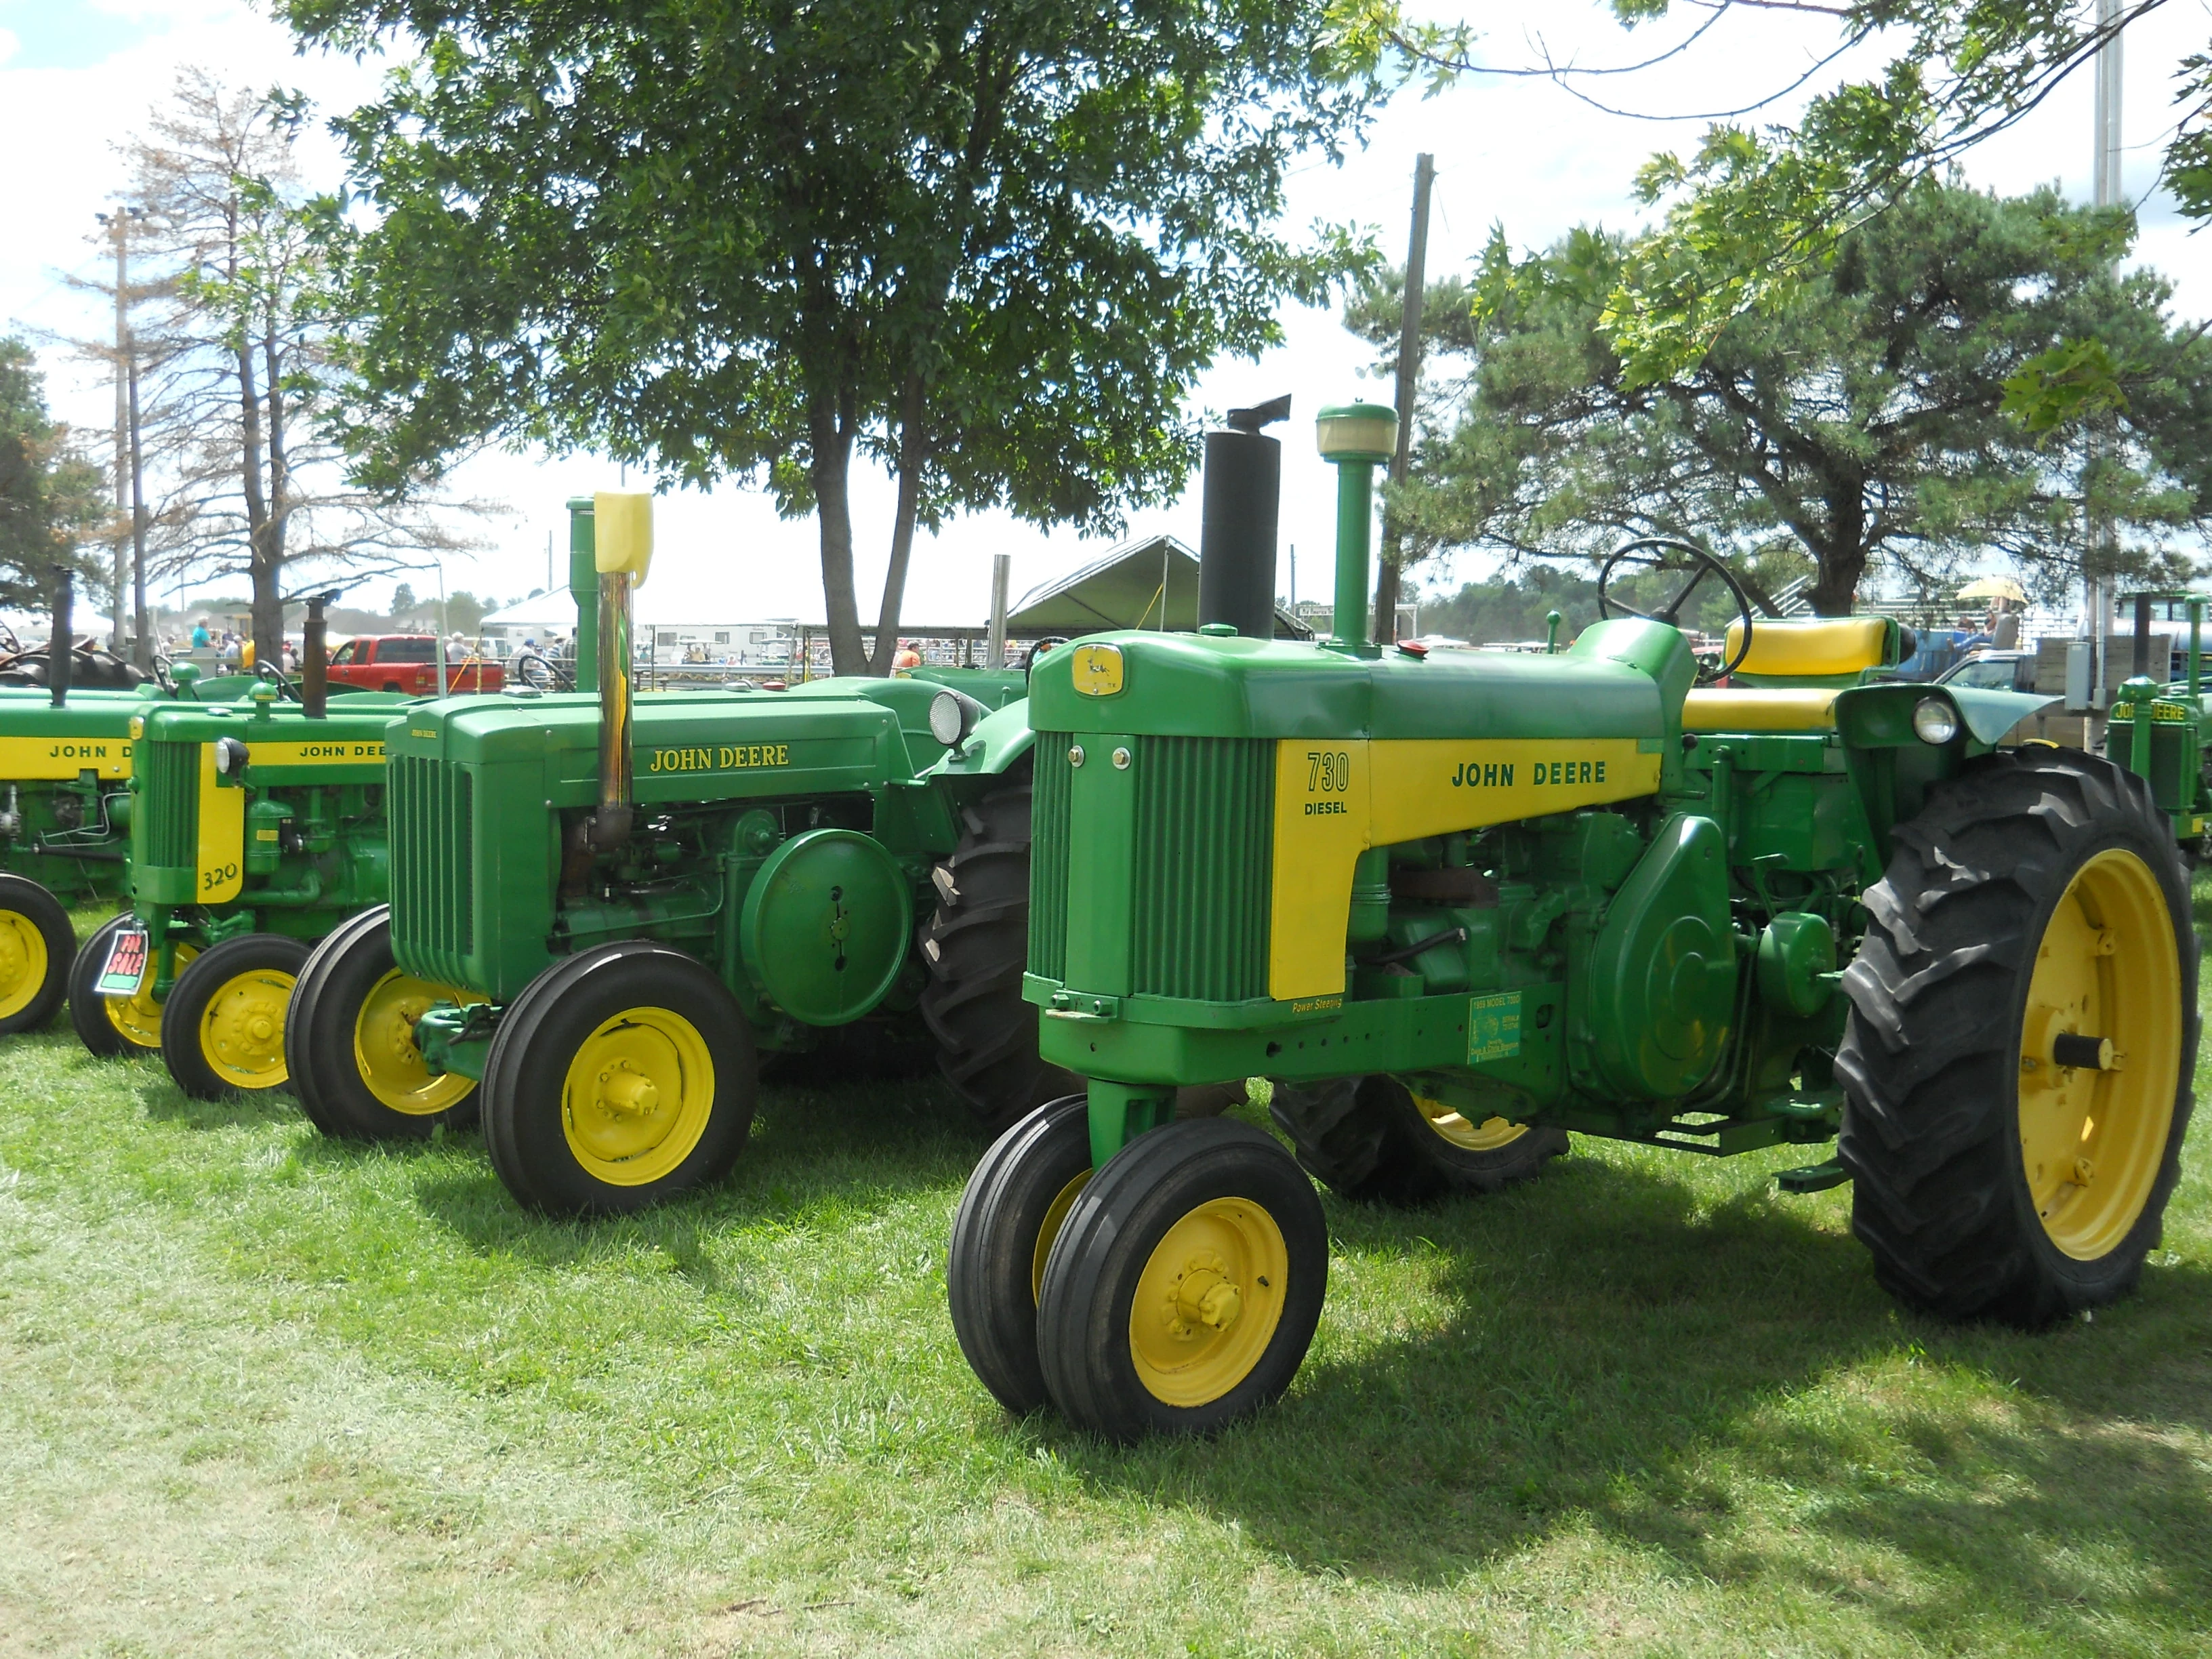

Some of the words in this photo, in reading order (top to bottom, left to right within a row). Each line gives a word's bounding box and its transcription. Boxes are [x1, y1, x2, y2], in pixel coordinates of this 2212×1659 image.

[49, 745, 106, 758] JOHN
[300, 746, 345, 757] JOHN
[650, 748, 713, 772] JOHN
[719, 745, 789, 769] DEERE
[1307, 752, 1349, 792] 730
[1452, 763, 1515, 787] JOHN
[1534, 761, 1606, 785] DEERE
[1305, 801, 1347, 815] DIESEL
[204, 862, 239, 891] 320
[121, 935, 142, 954] FOR
[108, 952, 144, 975] SALE
[1292, 1002, 1313, 1013] Power
[1487, 997, 1505, 1007] MODEL
